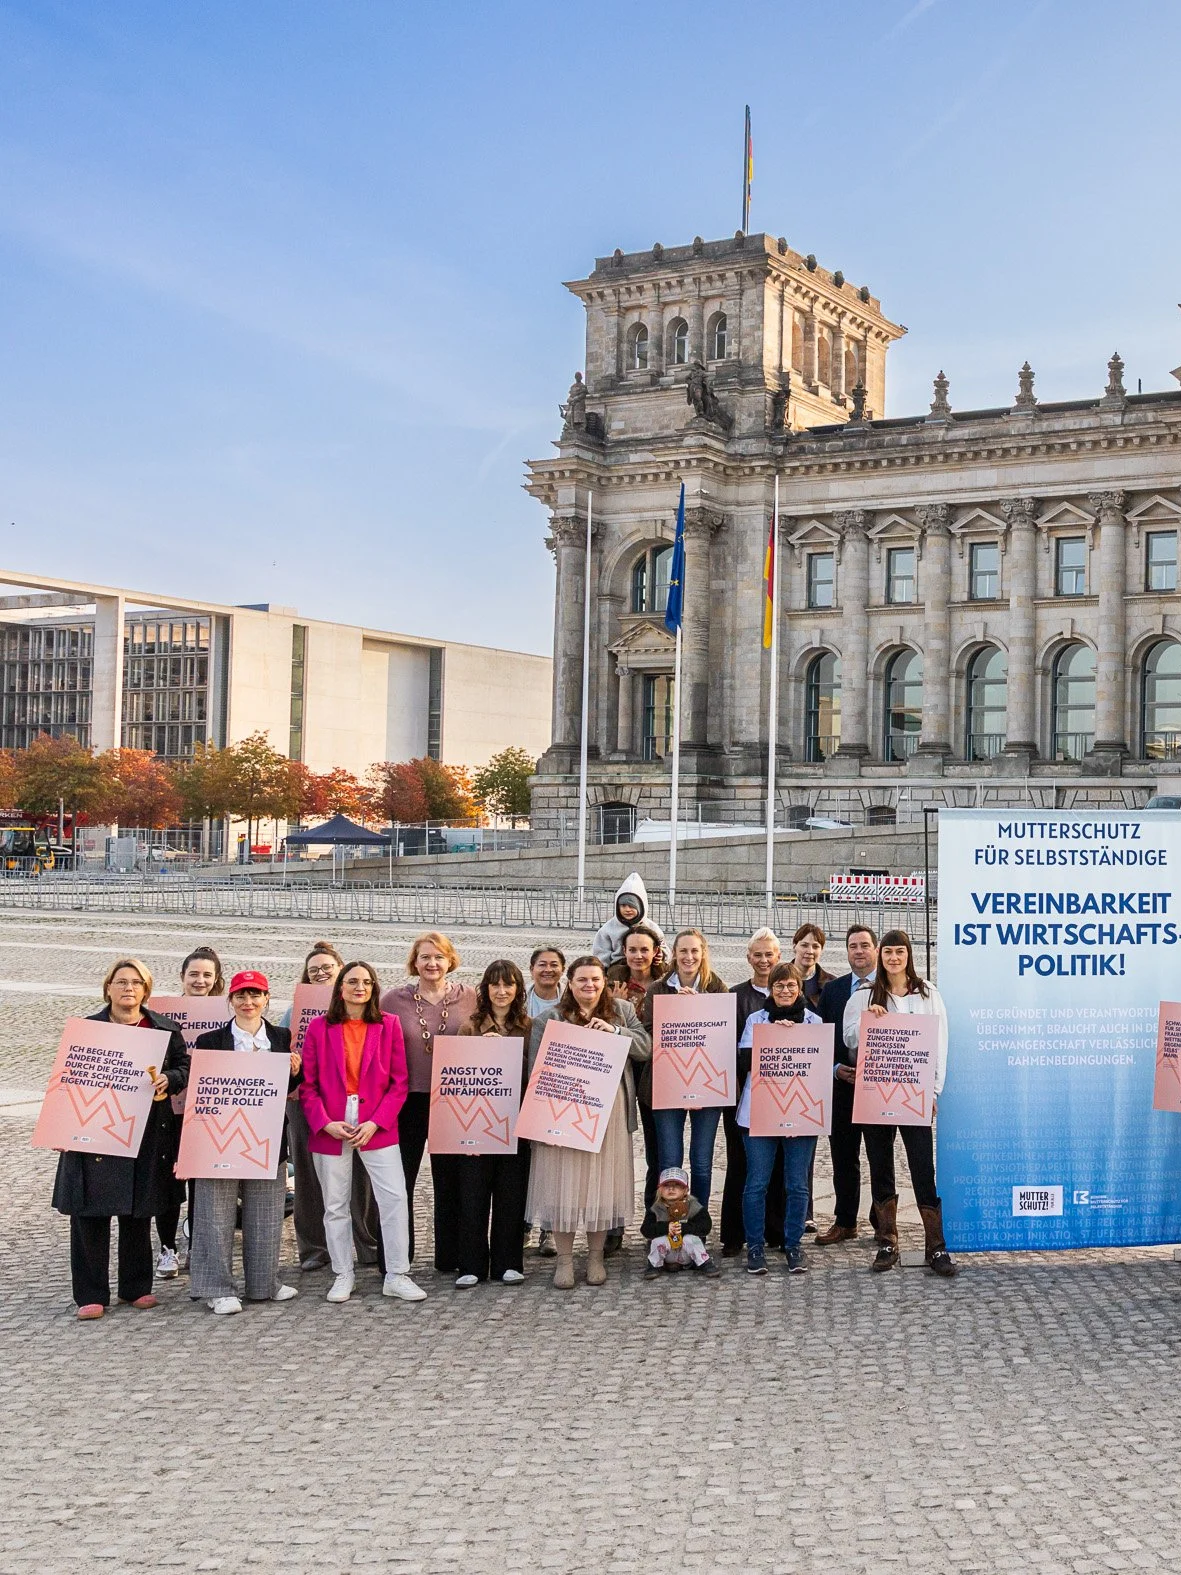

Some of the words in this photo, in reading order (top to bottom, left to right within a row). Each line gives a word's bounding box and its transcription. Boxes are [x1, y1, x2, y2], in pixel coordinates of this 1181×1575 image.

[998, 823, 1140, 839] MUTTERSCHUTZ
[975, 845, 1009, 865] FÜR
[1015, 846, 1167, 866] SELBSTSTÄNDIGE
[971, 893, 1171, 914] VEREINBARKEIT
[954, 924, 991, 945] IST
[1018, 954, 1125, 976] POLITIK!
[970, 1009, 994, 1019] WER
[996, 1007, 1047, 1019] GRÜNDET
[1051, 1008, 1073, 1018] UND
[1076, 1008, 1159, 1018] VERANTWORTU
[977, 1024, 1044, 1035] ÜBERNIMMT,
[1048, 1024, 1097, 1034] BRAUCHT
[1100, 1024, 1129, 1034] AUCH
[1132, 1024, 1142, 1033] IN
[1146, 1023, 1158, 1032] DE
[978, 1039, 1086, 1051] SCHWANGERSCHAFT
[1089, 1037, 1157, 1050] VERLÄSSLICH
[86, 1048, 124, 1058] BEGLEITE
[67, 1053, 101, 1063] ANDERE
[103, 1058, 133, 1067] SICHER
[1008, 1054, 1136, 1066] RAHMENBEDINGUNGEN.
[65, 1061, 95, 1070] DURCH
[112, 1068, 144, 1077] GEBURT
[441, 1067, 477, 1075] ANGST
[91, 1072, 130, 1083] SCHÜTZT
[199, 1077, 265, 1086] SCHWANGER
[440, 1077, 502, 1085] ZAHLUNGS-
[61, 1077, 109, 1088] EIGENTLICH
[111, 1084, 138, 1092] MICH?
[222, 1086, 278, 1096] PLÖTZLICH
[440, 1086, 512, 1096] UNFÄHIGKEIT!
[232, 1098, 263, 1106] ROLLE
[1020, 1192, 1048, 1200] MUTTER
[1020, 1201, 1048, 1210] SCHUTZ!
